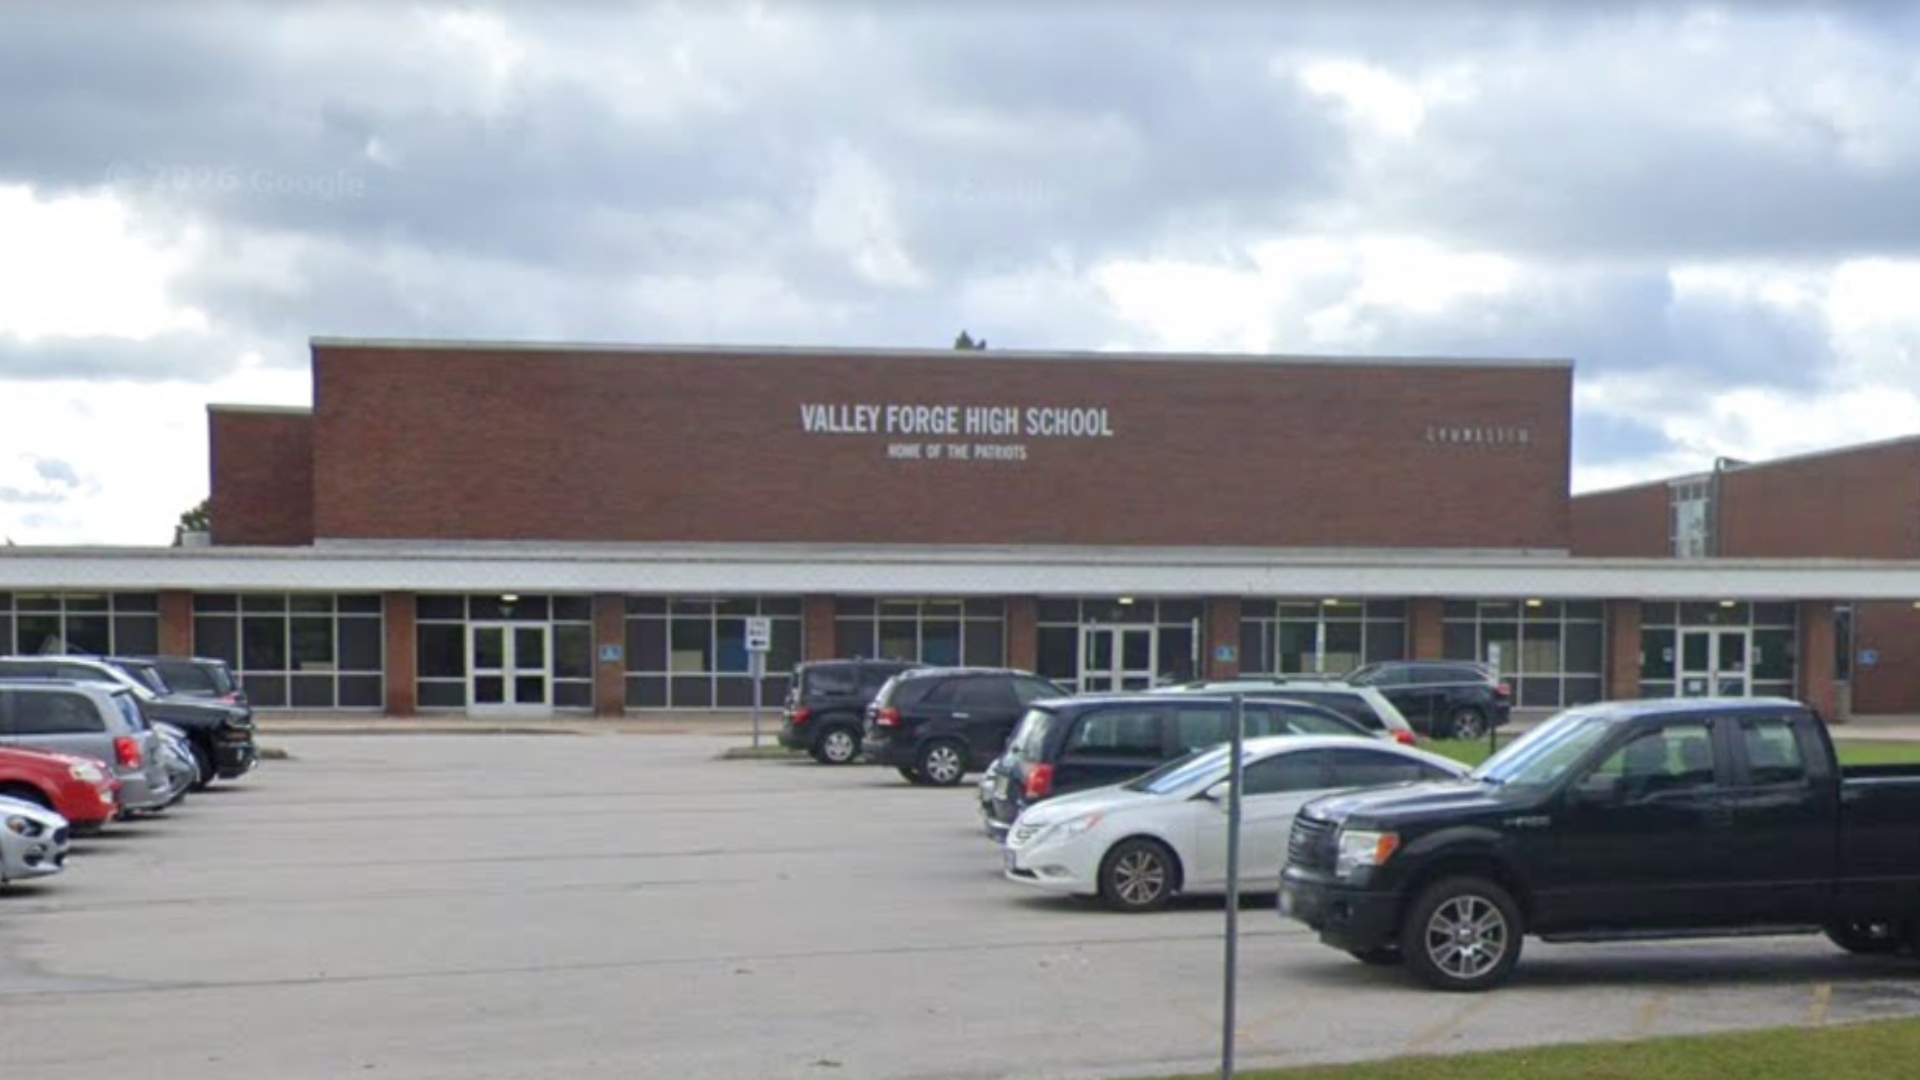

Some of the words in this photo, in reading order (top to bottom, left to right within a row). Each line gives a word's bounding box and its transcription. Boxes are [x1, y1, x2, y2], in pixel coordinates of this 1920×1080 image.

[801, 404, 880, 432] VALLEY
[886, 405, 958, 434] FORGE
[966, 406, 1018, 434] HIGH
[1026, 407, 1114, 436] SCHOOL
[888, 443, 919, 459] HOME
[926, 443, 941, 459] OF
[947, 444, 968, 459] THE
[974, 444, 1027, 460] PATRIOTS
